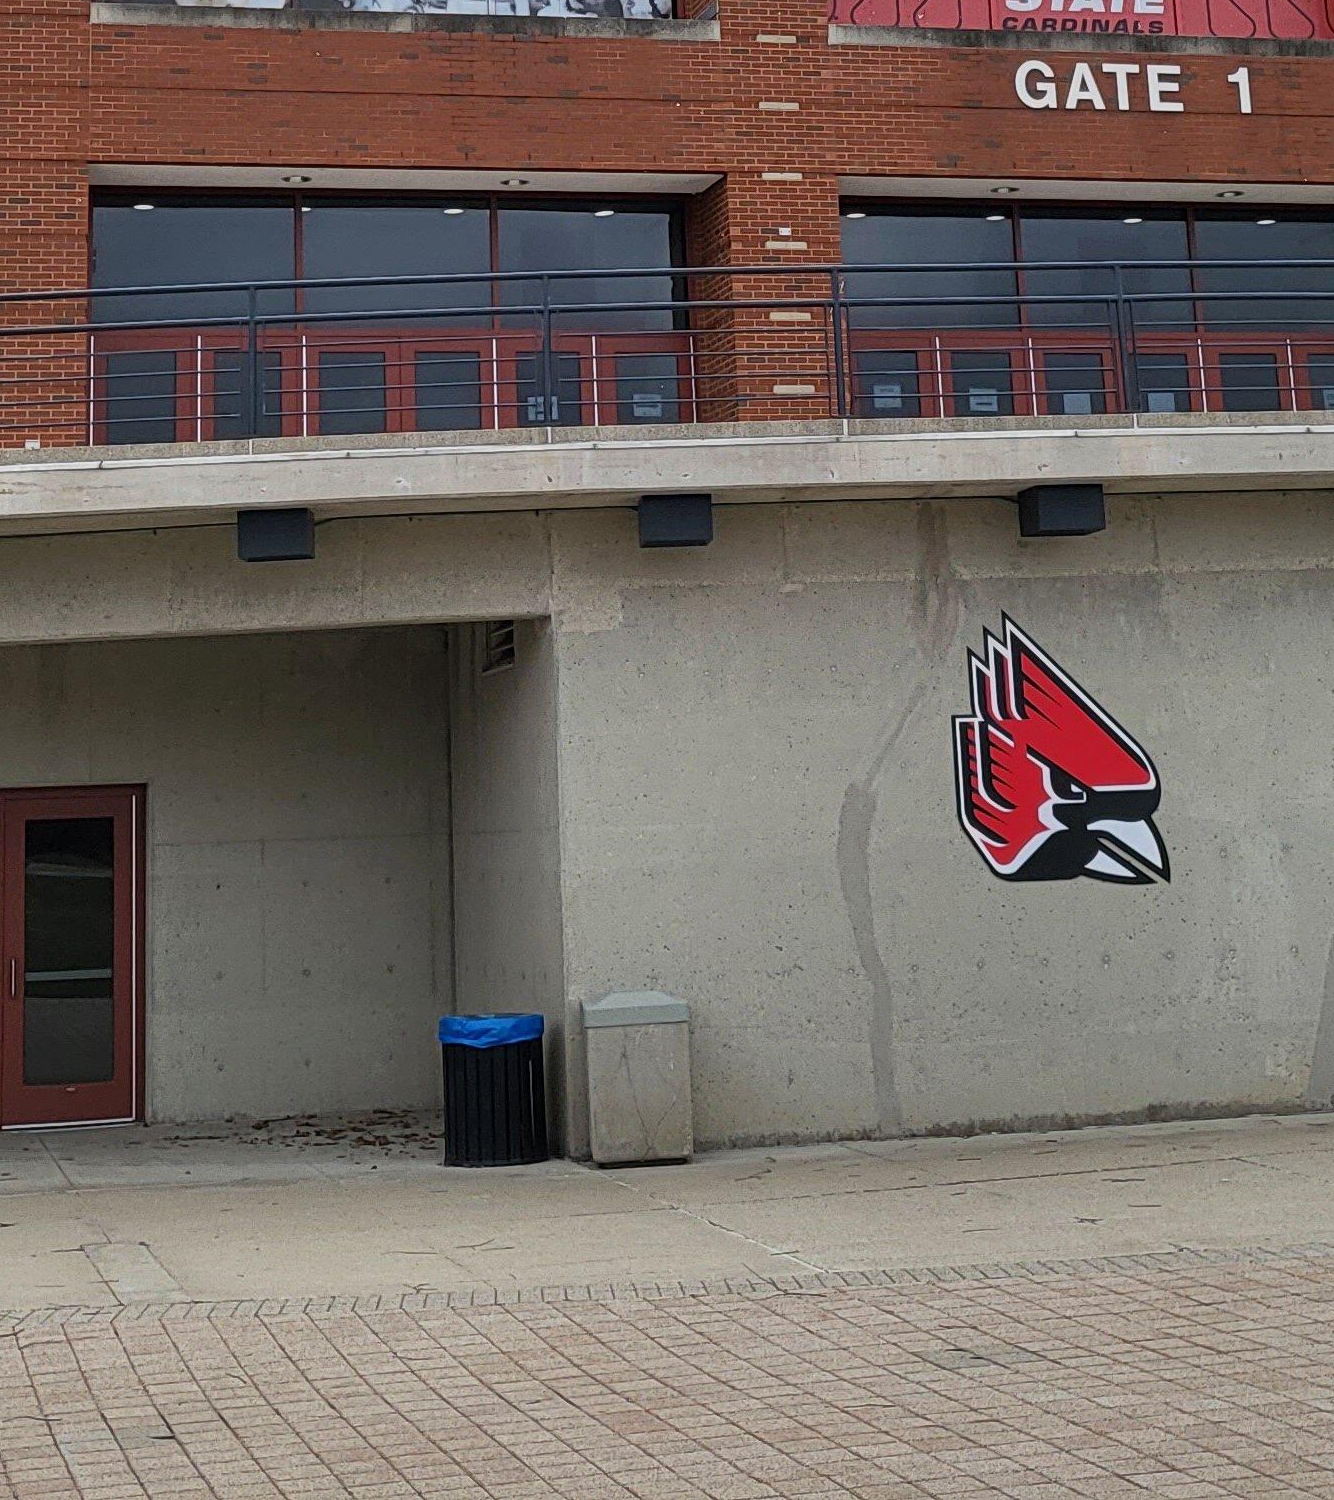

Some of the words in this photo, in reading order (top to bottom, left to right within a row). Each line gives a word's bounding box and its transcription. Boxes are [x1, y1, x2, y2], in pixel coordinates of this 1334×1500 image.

[1002, 16, 1165, 34] CARDINALS
[1014, 59, 1185, 113] GATE
[1226, 66, 1253, 114] 1
